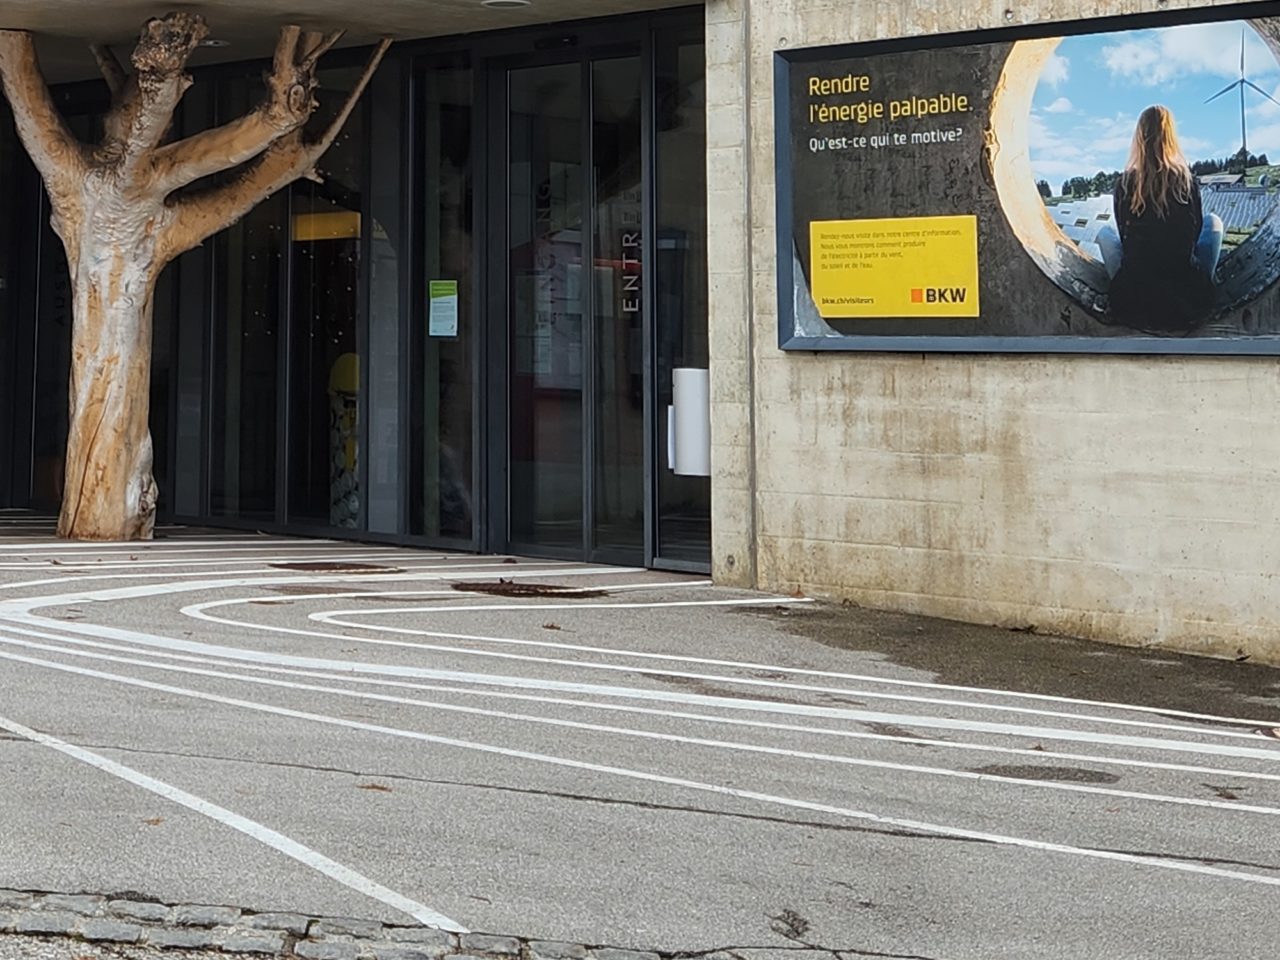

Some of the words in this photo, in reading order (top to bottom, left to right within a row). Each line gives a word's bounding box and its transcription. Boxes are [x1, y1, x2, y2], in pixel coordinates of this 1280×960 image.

[808, 74, 870, 96] Rendre
[809, 100, 884, 124] l'énergie
[889, 92, 974, 120] palpable.
[809, 135, 867, 153] Qu'est-ce
[870, 132, 890, 149] qui
[894, 132, 907, 145] te
[911, 127, 963, 144] motive?
[926, 288, 966, 303] BKW
